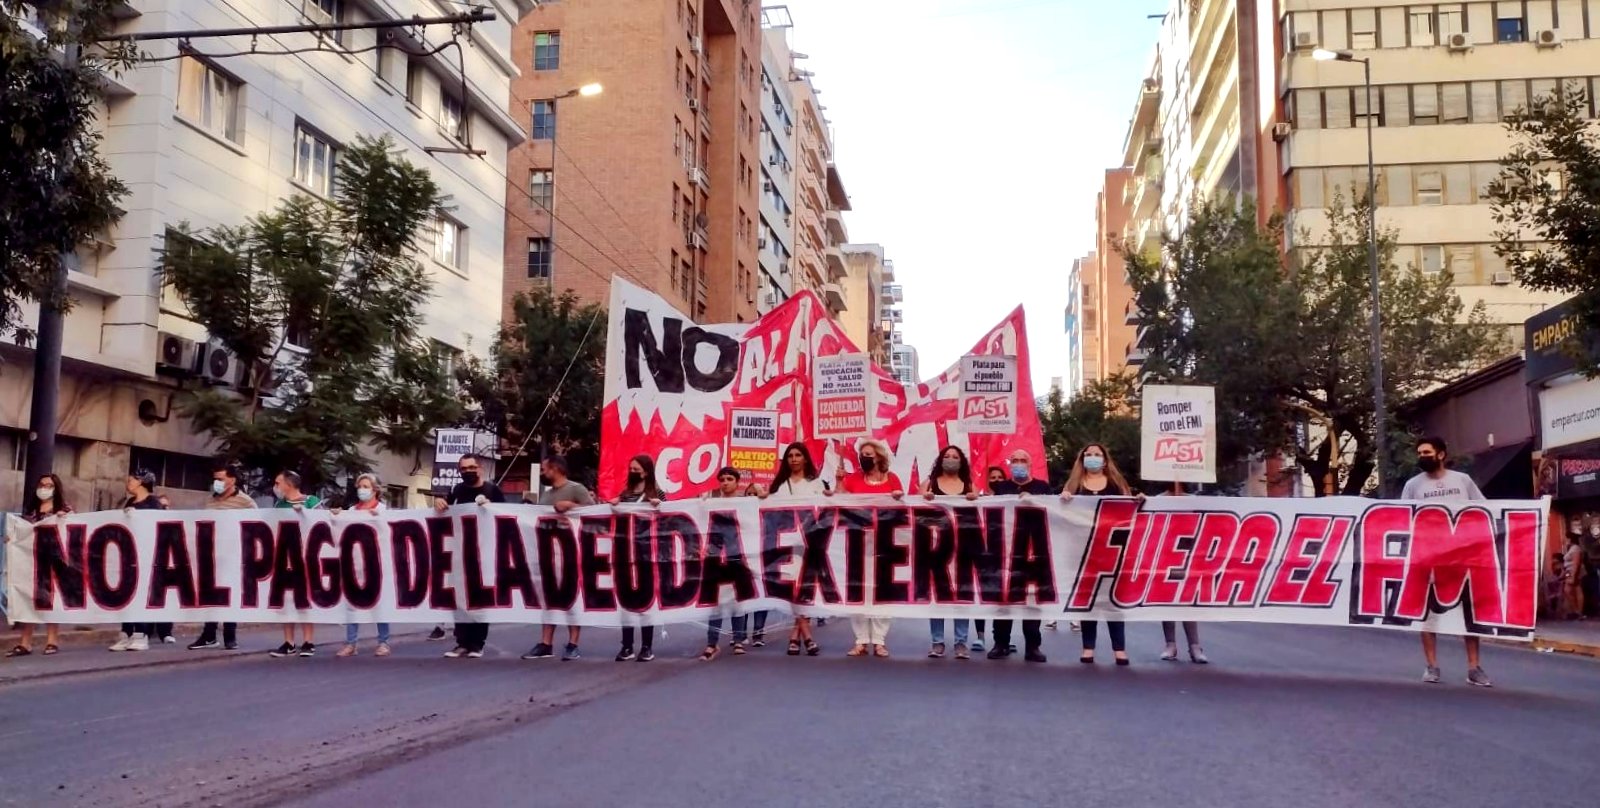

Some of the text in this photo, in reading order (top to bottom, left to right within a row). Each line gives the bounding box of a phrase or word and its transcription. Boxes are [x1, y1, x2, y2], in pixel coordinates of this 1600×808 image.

[625, 308, 740, 394] NO
[972, 360, 1005, 370] Plata para
[974, 370, 1003, 380] el pueblo
[820, 399, 864, 416] IZQUIERDA
[964, 395, 1008, 418] MST
[1157, 402, 1192, 416] Romper
[736, 416, 771, 428] NI AJUSTE
[819, 415, 865, 430] SOCIALISTA
[1160, 415, 1202, 432] con el FMI
[732, 427, 775, 440] NI TARIFAZOS
[731, 450, 776, 461] PARTIDO
[1154, 437, 1204, 463] MST
[732, 460, 774, 470] OBRERO
[432, 477, 464, 486] OBRER
[33, 497, 1542, 638] NO AL PAGO DE LA DEUDA EXTERNA FUERA EL FMI
